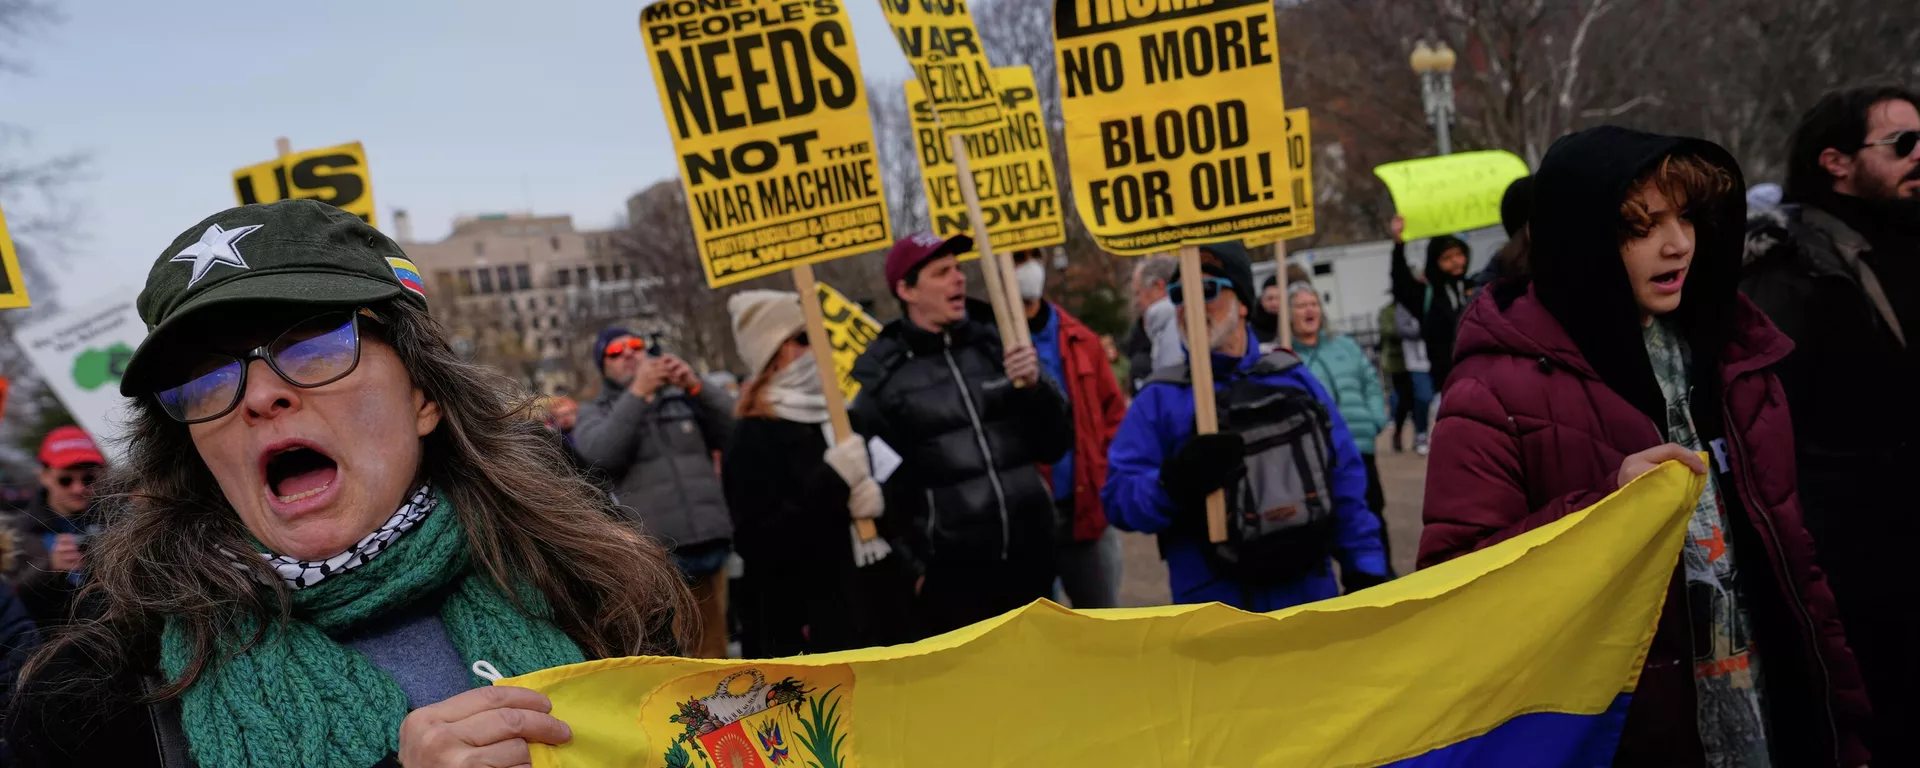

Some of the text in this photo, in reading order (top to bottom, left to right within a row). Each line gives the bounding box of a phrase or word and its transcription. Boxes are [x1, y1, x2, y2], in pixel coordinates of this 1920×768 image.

[646, 0, 759, 21] MONE
[649, 0, 839, 45] PEOPLE'S
[895, 26, 979, 57] WAR
[1062, 42, 1124, 98] NO
[1140, 14, 1272, 84] MORE
[657, 20, 856, 139] NEEDS
[683, 130, 869, 185] NOT THE
[1100, 99, 1249, 169] BLOOD
[238, 154, 363, 207] US
[694, 159, 877, 231] WAR MACHINE
[1089, 170, 1174, 227] FOR
[1190, 152, 1274, 212] OIL!
[936, 196, 1054, 235] NOW!
